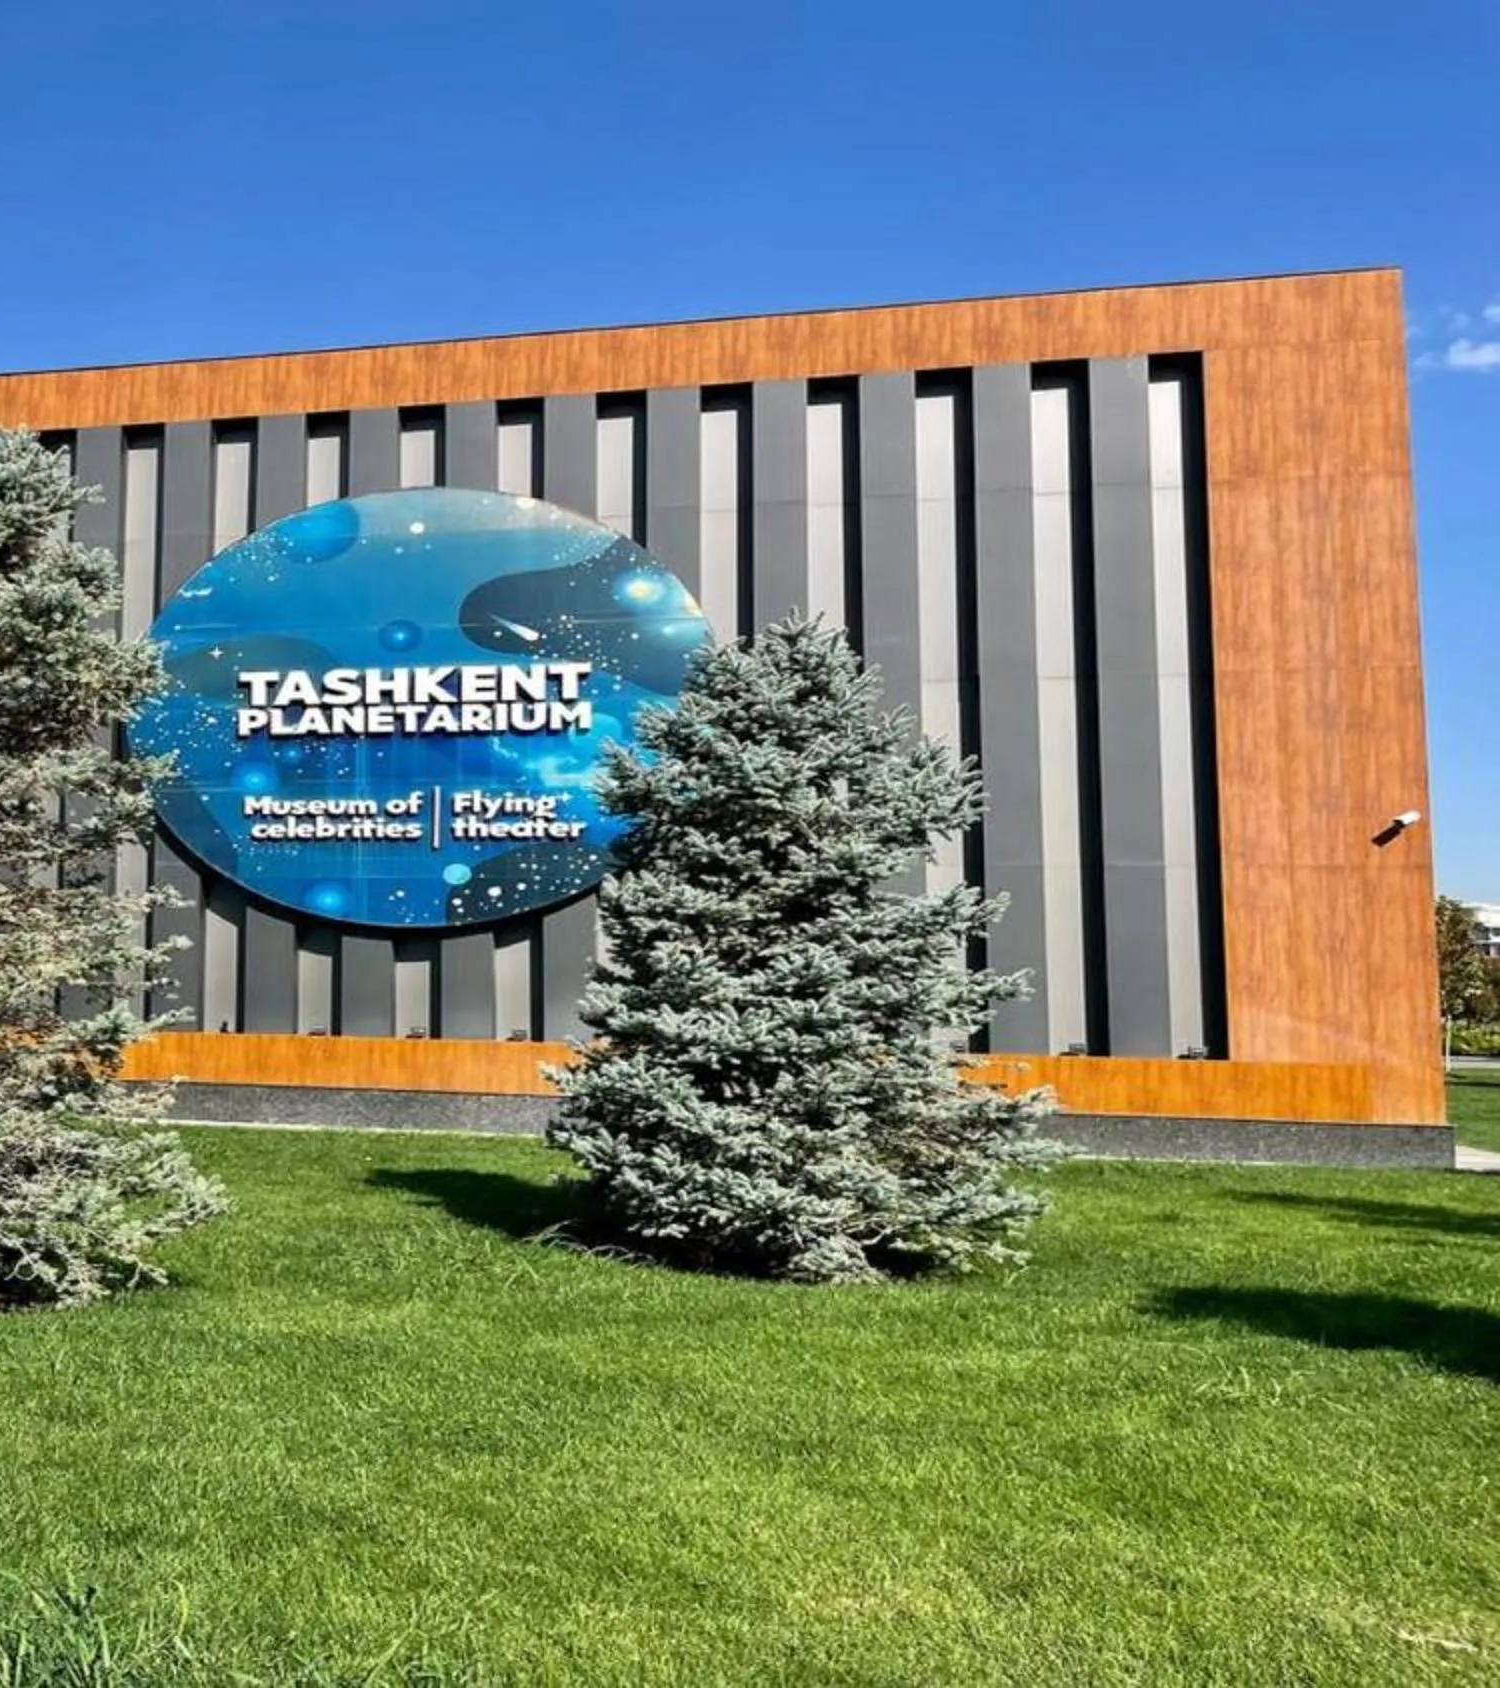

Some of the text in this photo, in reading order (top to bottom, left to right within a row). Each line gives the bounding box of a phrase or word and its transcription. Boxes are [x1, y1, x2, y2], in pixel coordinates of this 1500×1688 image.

[238, 662, 592, 706] TASHKENT
[238, 701, 592, 737] PLANETARIUM
[243, 791, 424, 815] Museum of
[452, 789, 557, 819] Flying
[250, 815, 424, 839] celebrities
[452, 815, 588, 839] theater
